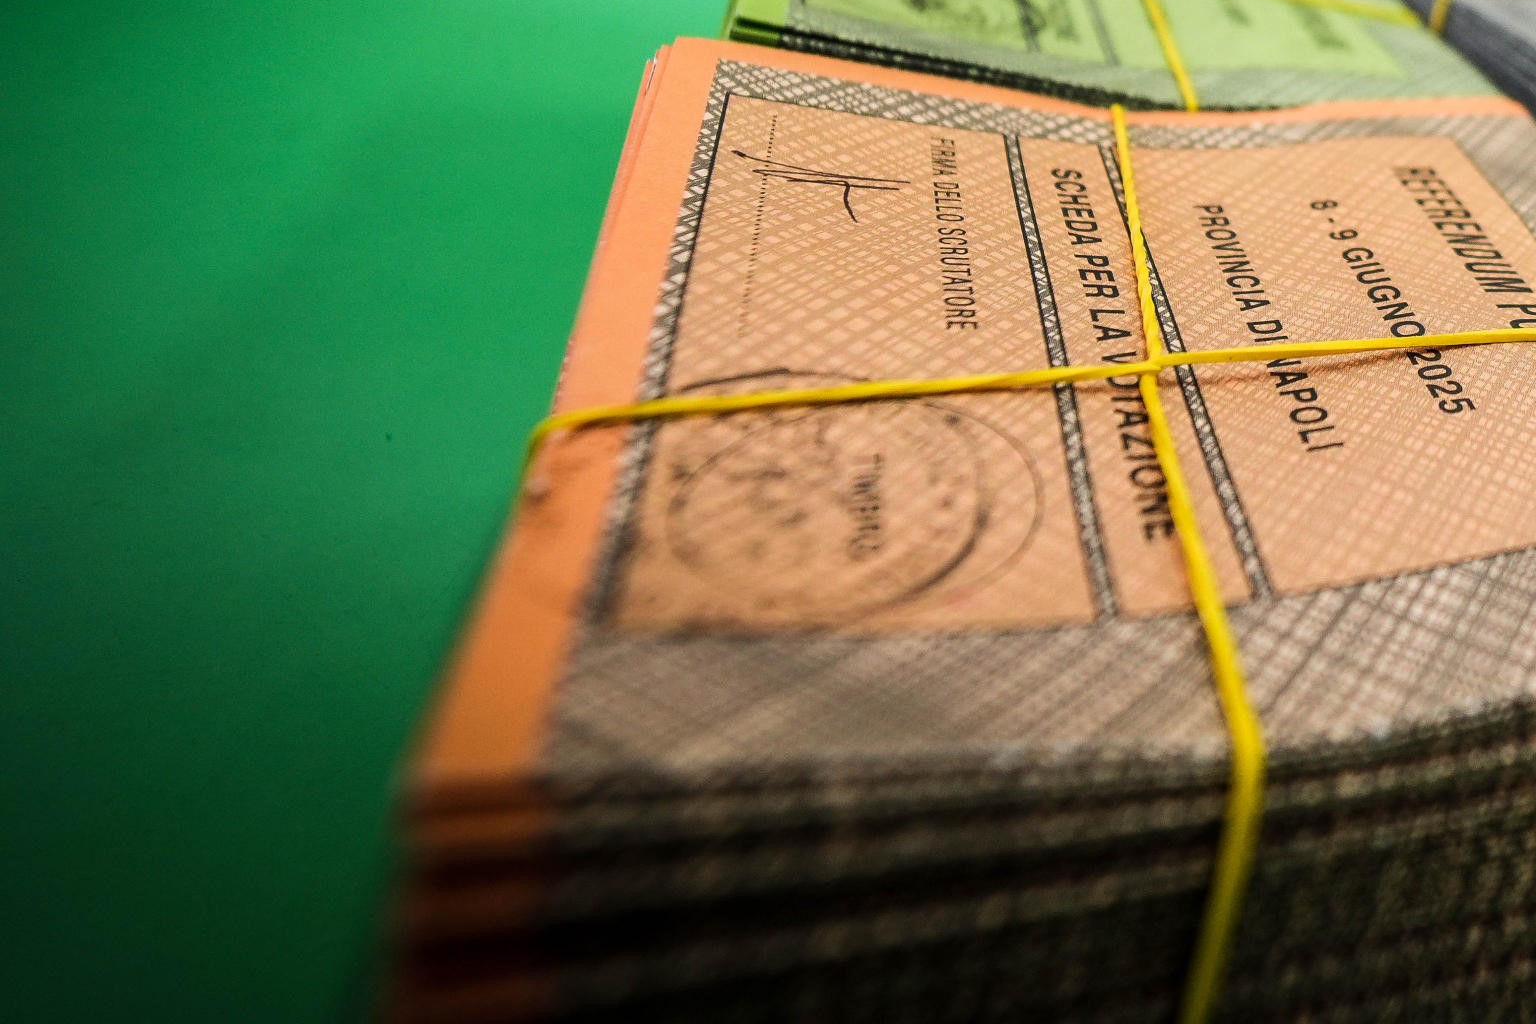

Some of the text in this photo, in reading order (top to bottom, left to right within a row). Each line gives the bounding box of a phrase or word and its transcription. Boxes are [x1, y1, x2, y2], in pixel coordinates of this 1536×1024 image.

[931, 136, 978, 330] FIRMA DELLO SCRUTATORE
[1051, 167, 1103, 246] SCHEDA
[1310, 199, 1338, 211] 8
[1329, 228, 1359, 242] 9
[1394, 166, 1534, 294] REFERENDUM
[1074, 253, 1120, 298] PER
[1193, 204, 1271, 312] PROVINCIA
[1246, 318, 1289, 343] DI
[1342, 246, 1427, 338] GIUGNO
[1089, 308, 1133, 343] LA
[1406, 348, 1477, 414] 2025
